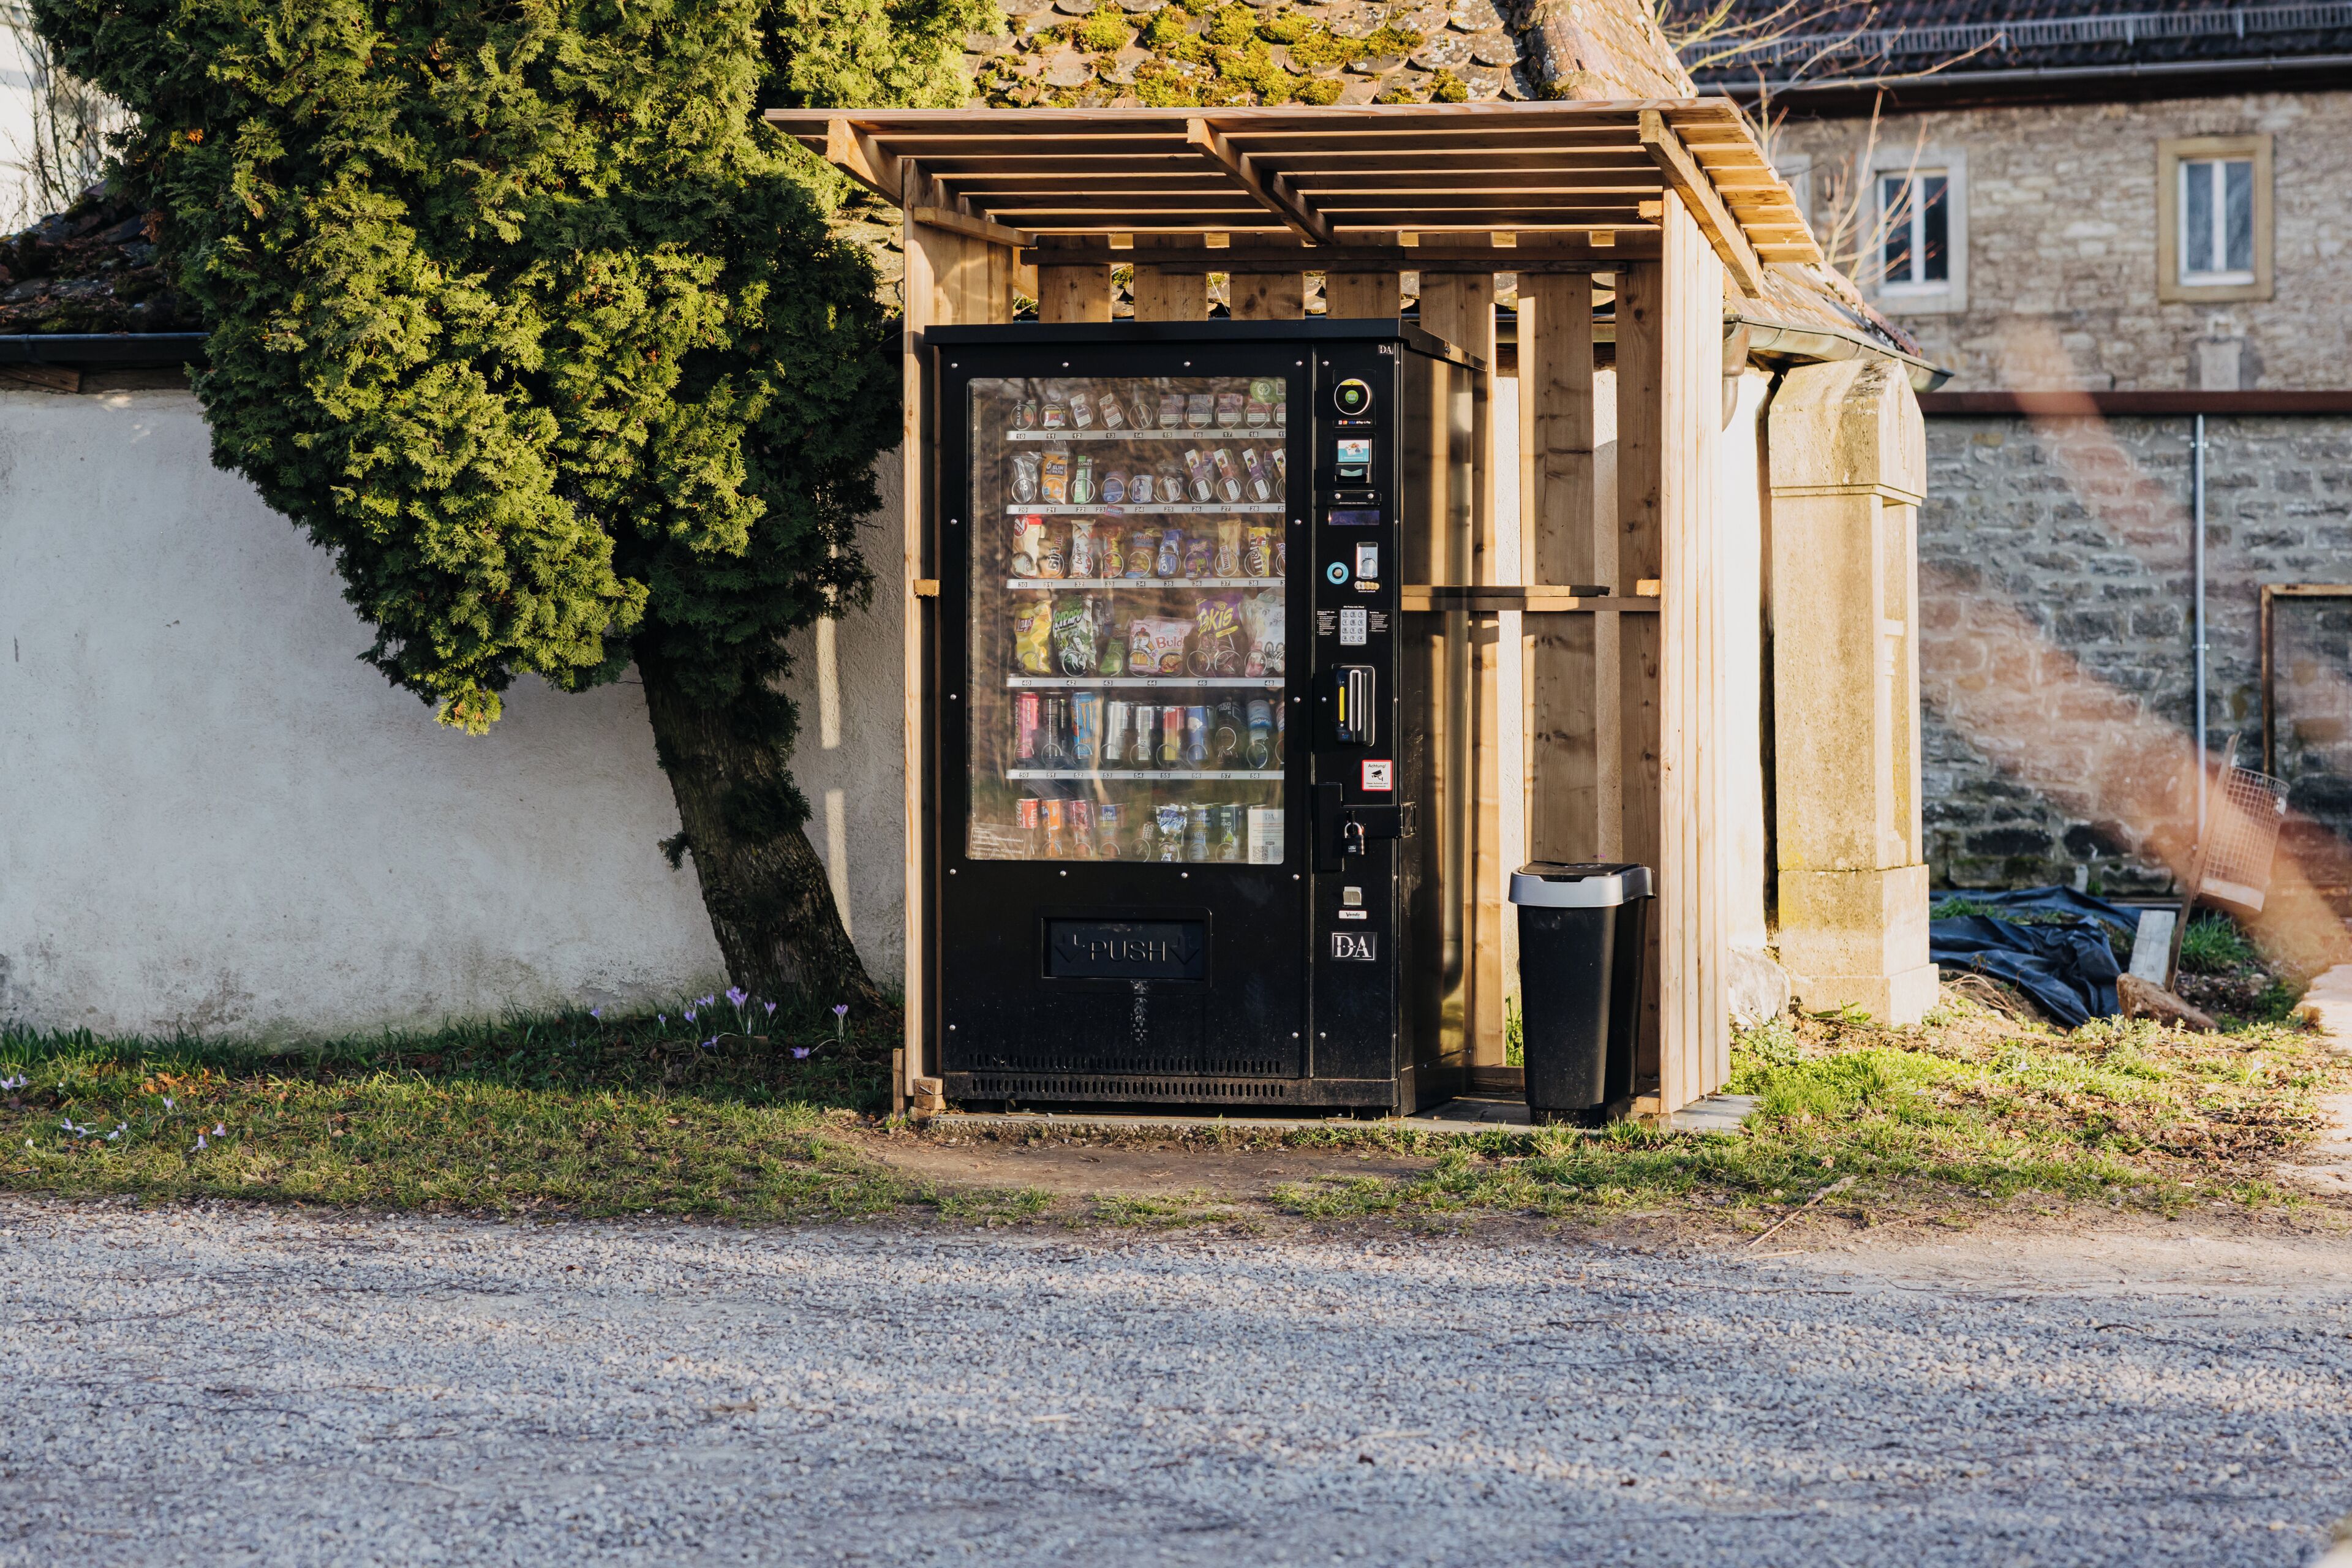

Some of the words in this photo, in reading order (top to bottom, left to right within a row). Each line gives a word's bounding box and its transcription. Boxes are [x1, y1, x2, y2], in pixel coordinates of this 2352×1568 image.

[1046, 460, 1054, 469] 6
[1091, 940, 1165, 962] PUSH
[1335, 935, 1372, 957] DA
